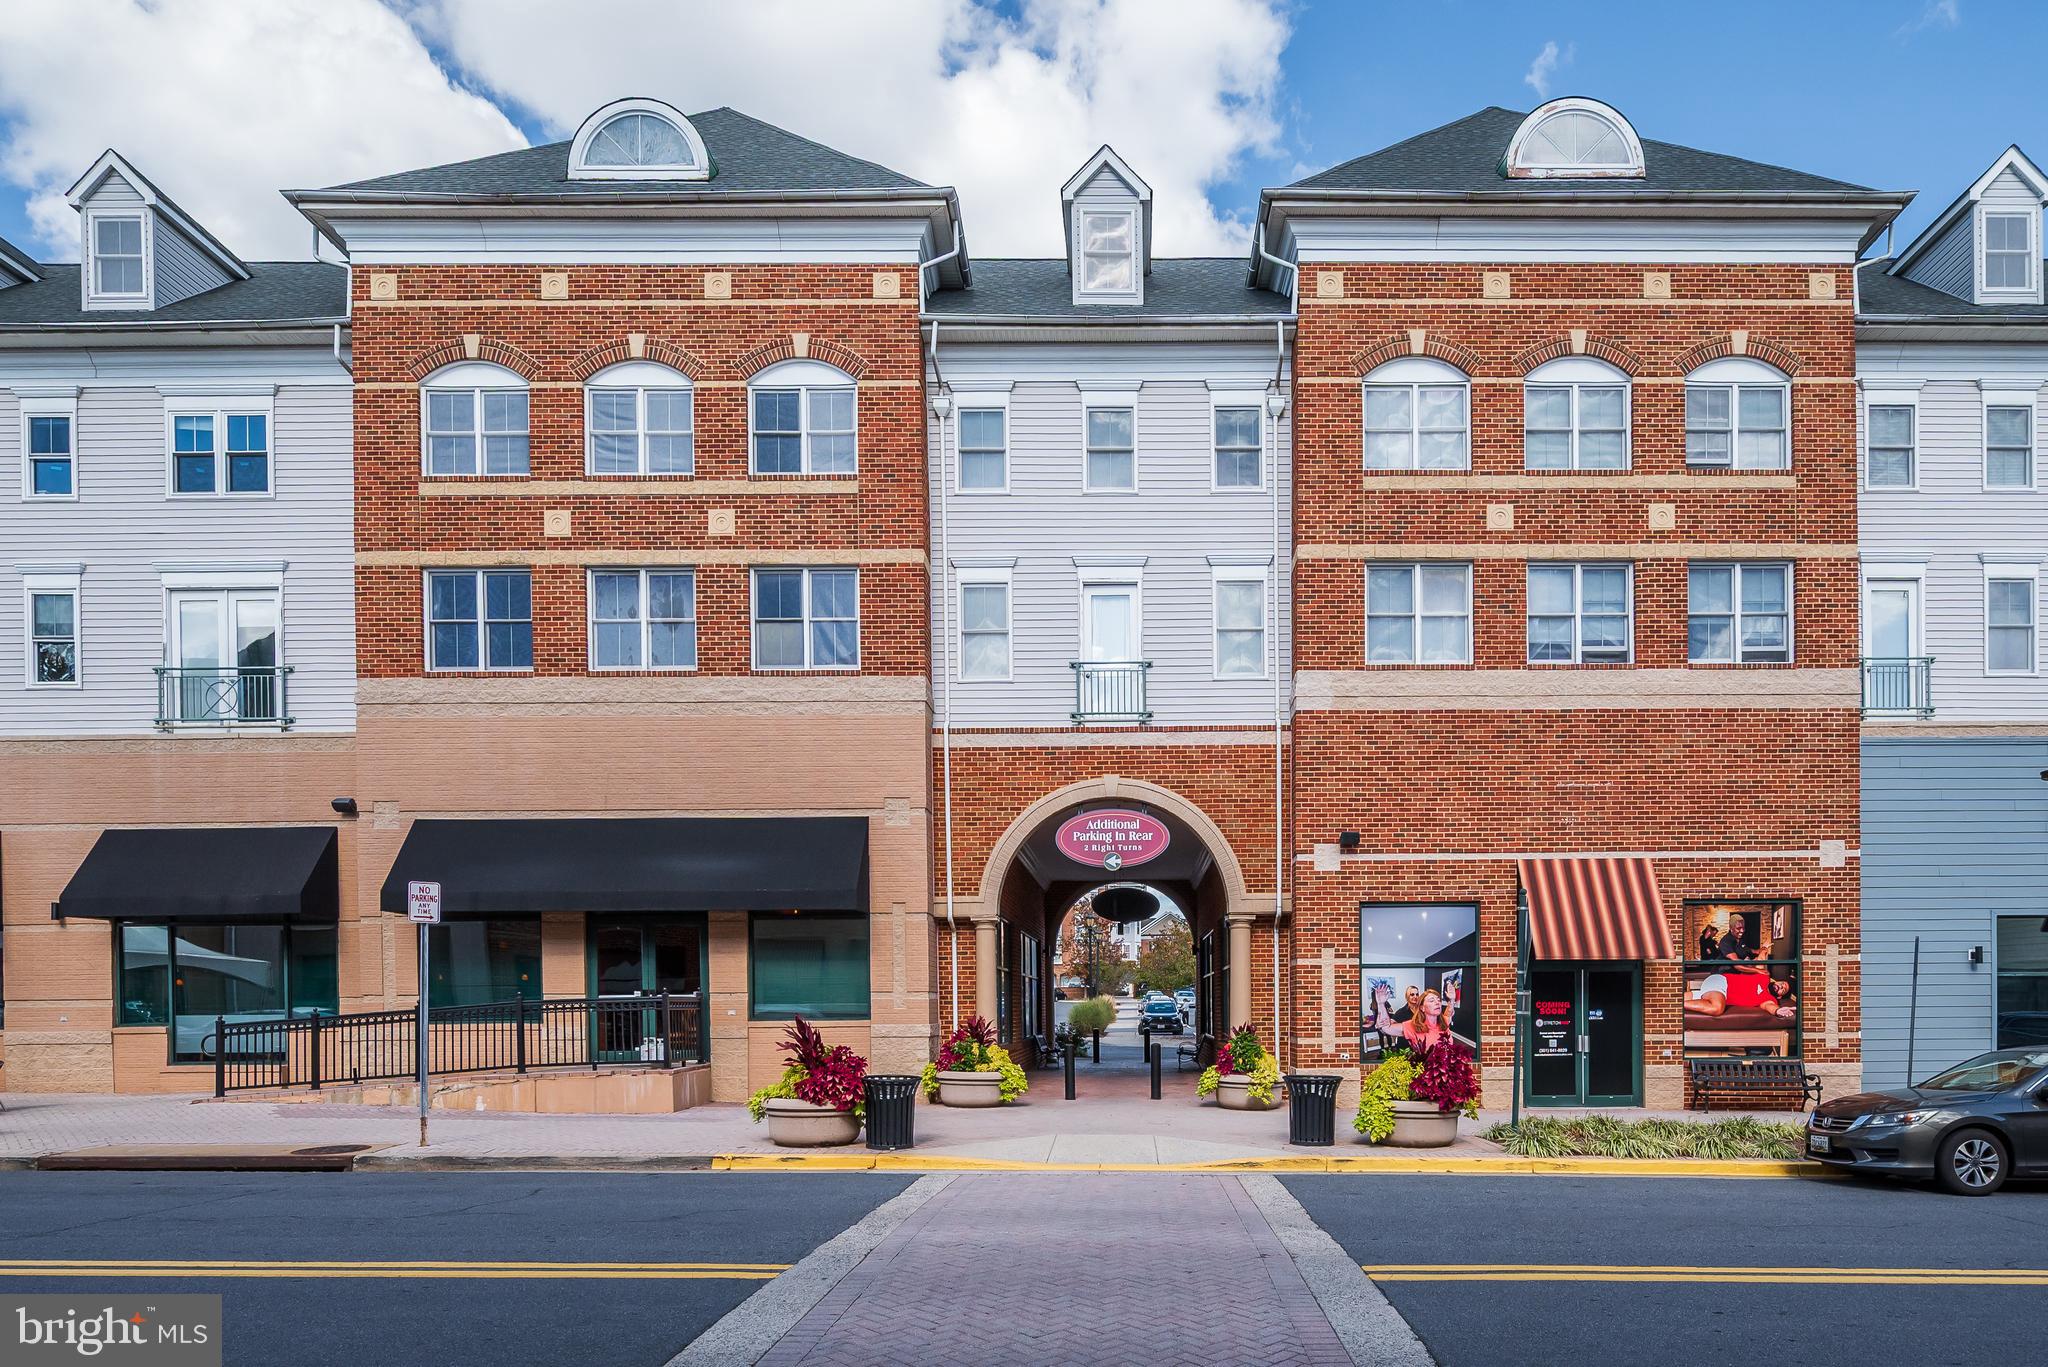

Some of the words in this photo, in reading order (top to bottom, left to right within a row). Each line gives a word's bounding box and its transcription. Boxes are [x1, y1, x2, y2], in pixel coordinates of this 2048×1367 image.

[1086, 819, 1140, 830] Additional
[1073, 831, 1112, 843] Parking
[1115, 832, 1126, 841] In
[1129, 832, 1153, 841] Rear
[1091, 844, 1115, 853] Right
[412, 894, 438, 902] PARKING
